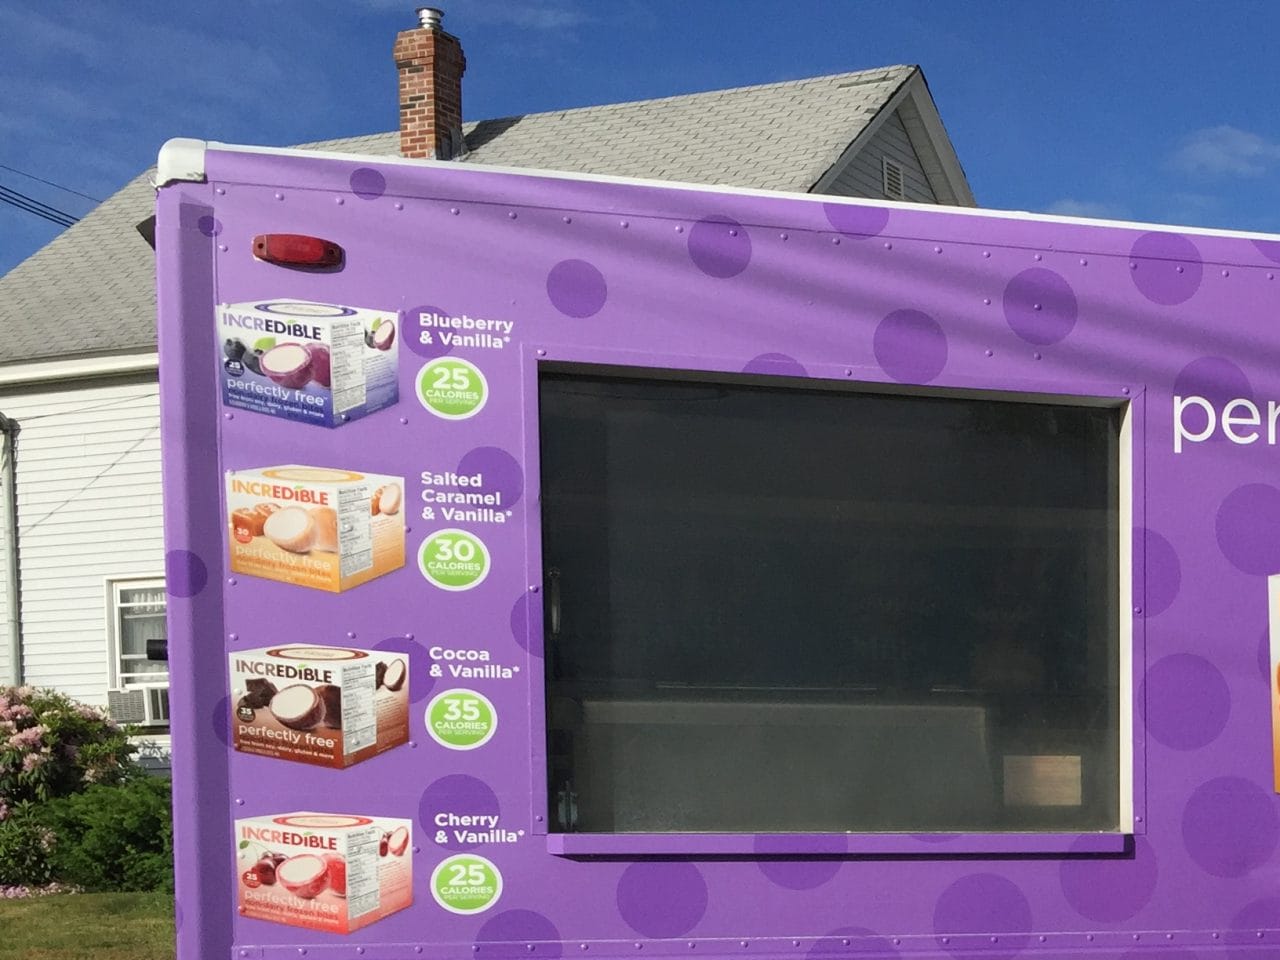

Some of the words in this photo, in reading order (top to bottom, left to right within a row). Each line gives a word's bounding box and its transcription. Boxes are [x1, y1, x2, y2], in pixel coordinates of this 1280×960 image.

[222, 312, 322, 341] INCREDIBLE
[419, 312, 514, 334] Blueberry
[419, 331, 433, 345] &
[432, 366, 470, 391] 25
[226, 377, 290, 400] perfectly
[295, 389, 325, 407] free
[425, 389, 480, 400] CALORIES
[421, 471, 482, 487] Salted
[232, 480, 329, 506] INCREDIBLE
[421, 489, 501, 505] Caramel
[422, 507, 435, 520] &
[235, 546, 298, 566] perfectly
[302, 555, 332, 570] free
[435, 539, 475, 561] 30
[427, 561, 481, 572] CALORIES
[429, 646, 490, 661] Cocoa
[236, 659, 332, 683] INCREDIBLE
[429, 664, 443, 677] &
[444, 699, 481, 721] 35
[239, 724, 301, 744] perfectly
[305, 734, 335, 748] free
[435, 721, 488, 731] CALORIES
[434, 813, 498, 828] Cherry
[241, 826, 337, 850] INCREDIBLE
[435, 831, 448, 844] &
[449, 864, 486, 886] 25
[244, 890, 307, 910] perfectly
[310, 899, 340, 913] free
[440, 886, 494, 895] CALORIES
